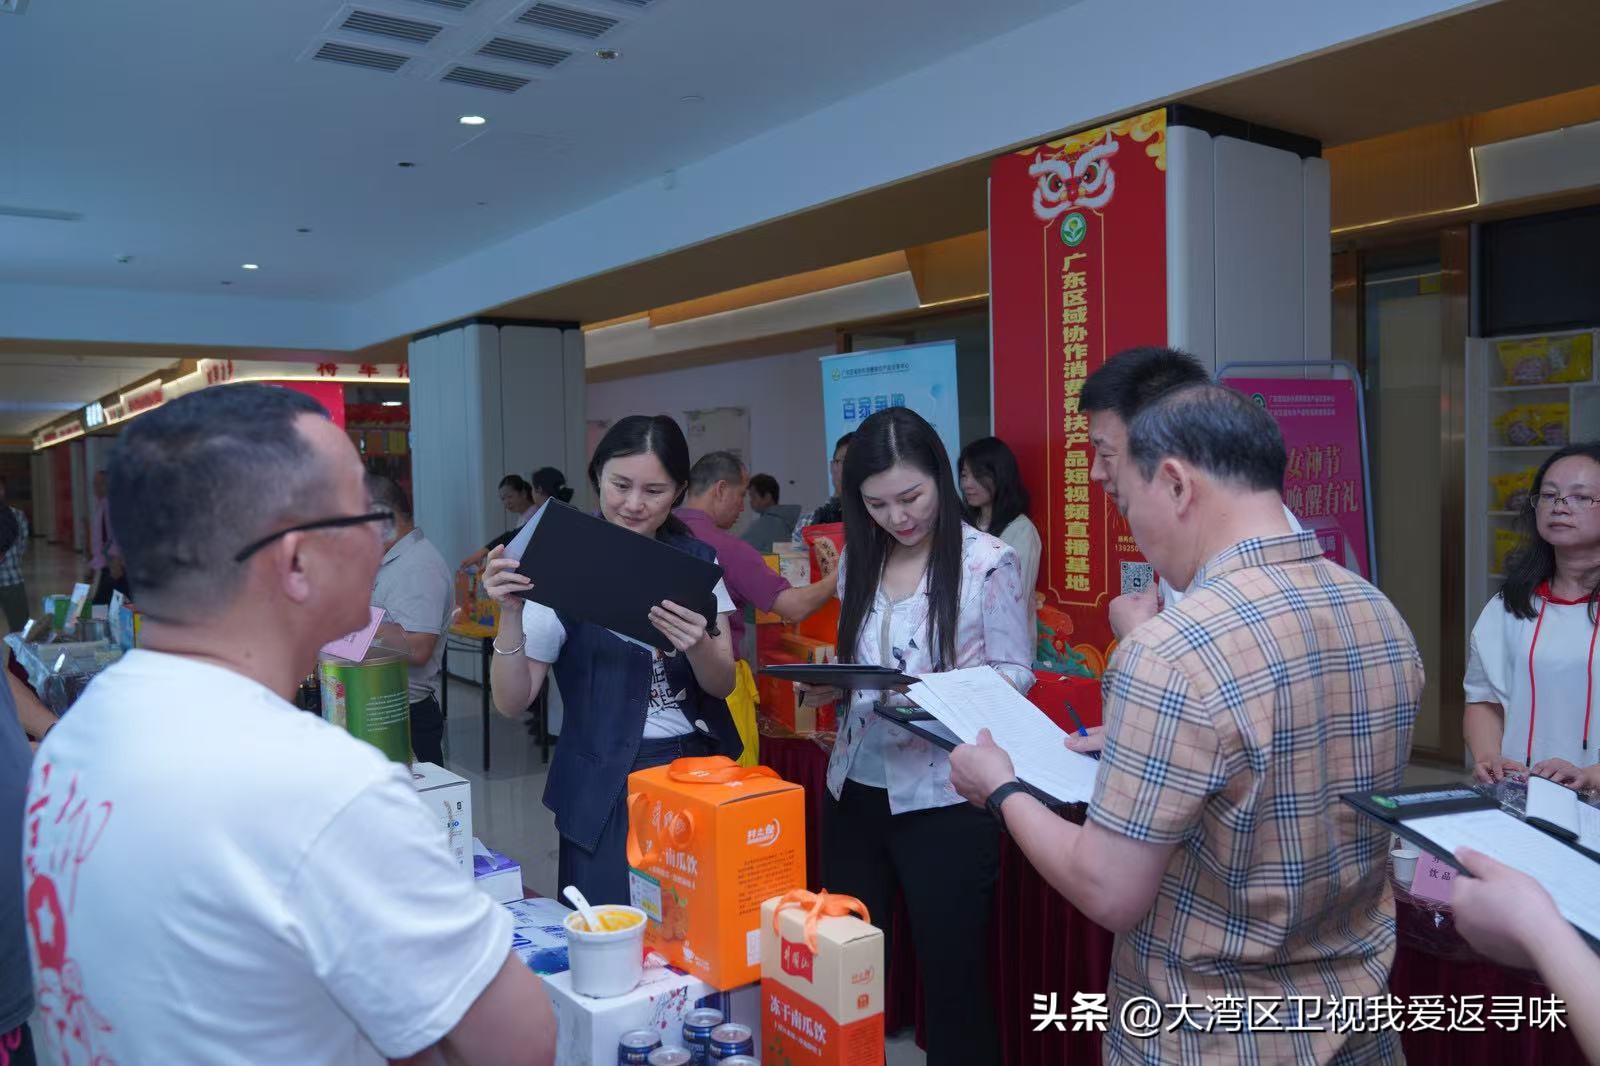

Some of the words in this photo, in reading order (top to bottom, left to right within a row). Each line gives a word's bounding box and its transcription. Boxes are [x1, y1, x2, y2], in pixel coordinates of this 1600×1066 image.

[1287, 445, 1341, 480] 女神节
[1429, 868, 1451, 880] 饮品
[770, 995, 827, 1045] 冻干南瓜饮
